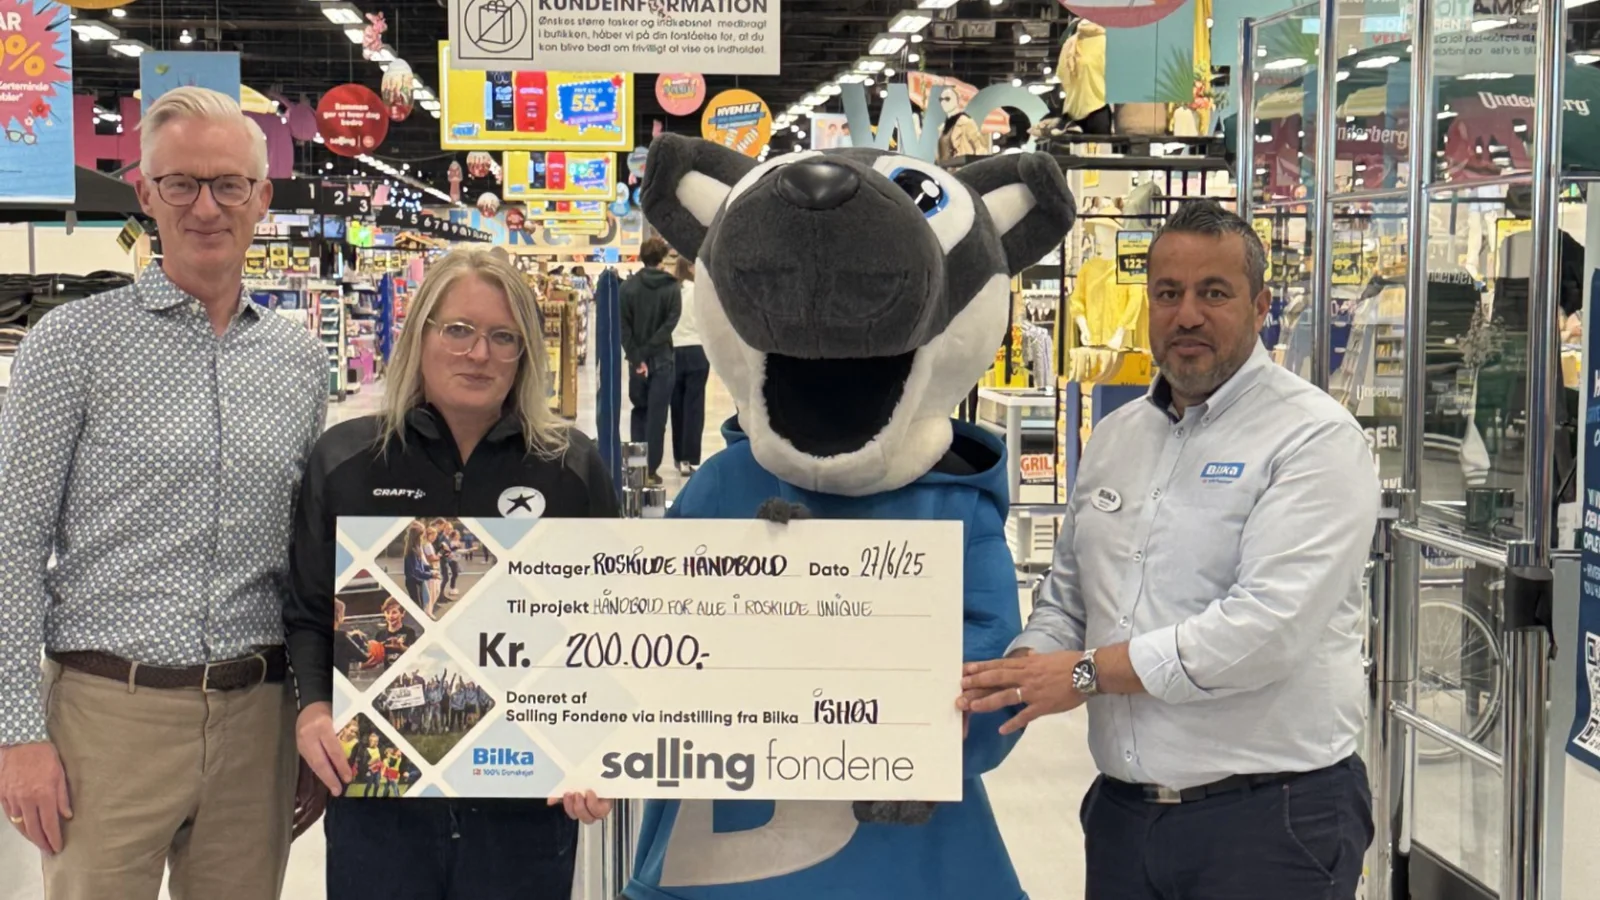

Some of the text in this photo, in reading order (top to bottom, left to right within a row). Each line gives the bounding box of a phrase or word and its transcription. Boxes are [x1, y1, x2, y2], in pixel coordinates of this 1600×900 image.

[538, 15, 767, 30] Ønskes større tasker og indkøbsnet medbragt
[543, 29, 590, 40] butikken,
[592, 29, 623, 40] håber
[625, 30, 634, 40] vi
[635, 31, 650, 41] på
[652, 30, 668, 41] din
[670, 30, 718, 41] forståelse
[738, 32, 749, 41] at
[750, 32, 765, 42] du
[538, 42, 558, 52] kan
[560, 42, 585, 53] blive
[587, 43, 611, 52] bedt
[613, 44, 630, 53] om
[632, 43, 667, 55] frivilligt
[668, 44, 680, 54] at
[681, 44, 701, 54] vise
[703, 46, 715, 55] os
[1477, 90, 1590, 116] Underg
[1336, 123, 1408, 149] nderberg
[309, 183, 315, 199] 1
[334, 191, 344, 205] 2
[359, 200, 369, 212] 3
[395, 208, 404, 220] 4
[411, 213, 418, 224] 5
[424, 217, 432, 227] 6
[434, 220, 440, 229] 7
[442, 222, 449, 231] 8
[373, 488, 413, 498] CRAFT
[683, 545, 788, 577] HÅNDBOLD
[860, 540, 926, 581] 27/6/25
[508, 560, 591, 579] Modtager
[809, 562, 850, 577] Dato
[507, 599, 590, 617] Til projekt
[593, 588, 664, 615] HÅNDBOLD
[667, 598, 694, 615] FOR
[696, 600, 727, 616] ALLE
[744, 600, 810, 616] ROSKILDE
[478, 632, 531, 668] Kr.
[506, 690, 588, 705] Doneret af
[506, 708, 799, 726] Salling Fondene via indstilling fra Bilka
[473, 747, 534, 766] Bilka
[600, 738, 914, 792] salling fondene
